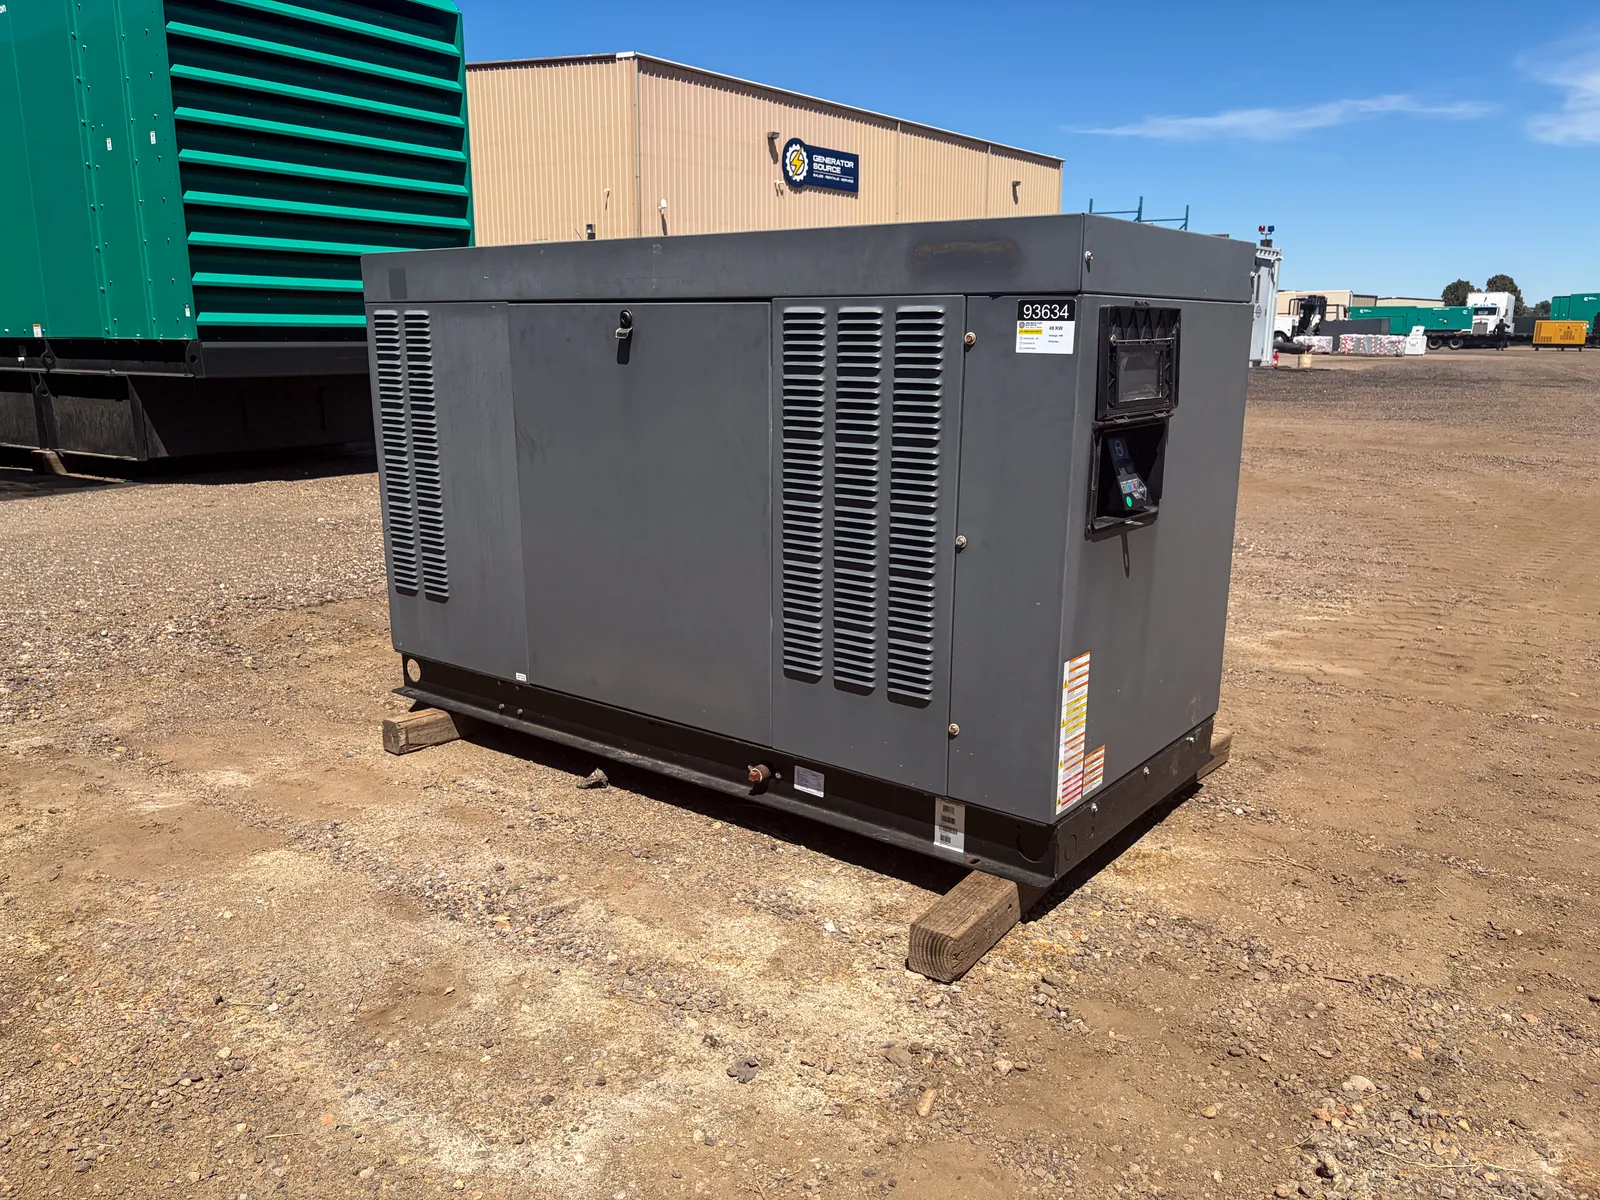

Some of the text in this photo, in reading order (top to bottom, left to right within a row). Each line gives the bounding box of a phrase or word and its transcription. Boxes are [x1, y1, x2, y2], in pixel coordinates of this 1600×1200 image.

[812, 154, 854, 168] GENERATOR
[812, 162, 842, 174] SOURCE
[1023, 304, 1069, 319] 93634
